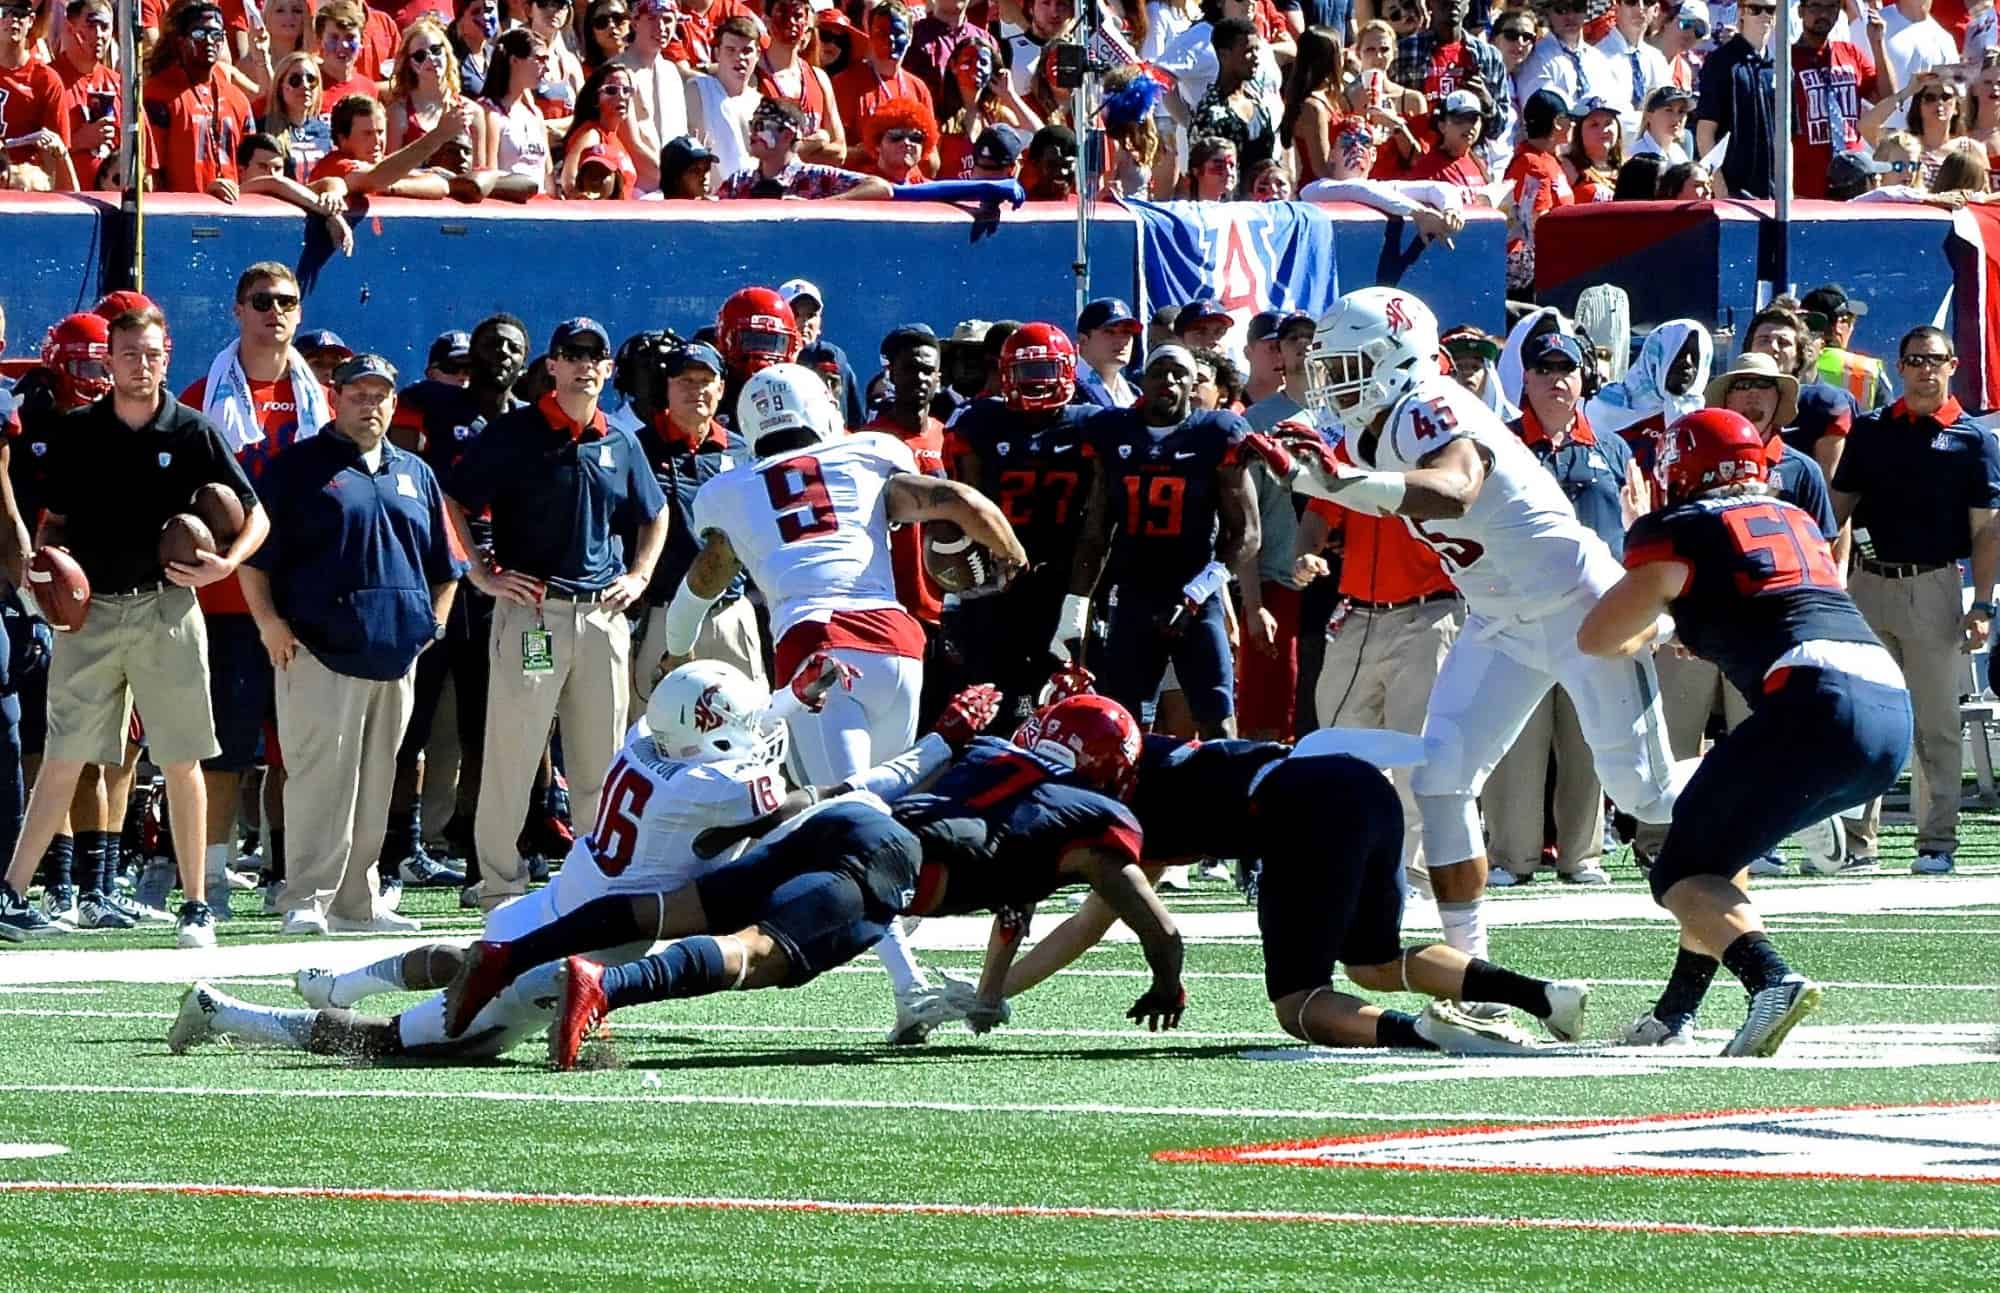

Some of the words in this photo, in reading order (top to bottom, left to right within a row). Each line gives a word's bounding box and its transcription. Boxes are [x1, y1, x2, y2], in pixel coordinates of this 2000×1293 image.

[1409, 396, 1458, 440] 45
[756, 455, 839, 544] 9
[1000, 470, 1079, 526] 27
[1121, 475, 1187, 537] 19
[585, 756, 655, 878] 16
[745, 775, 778, 817] 16
